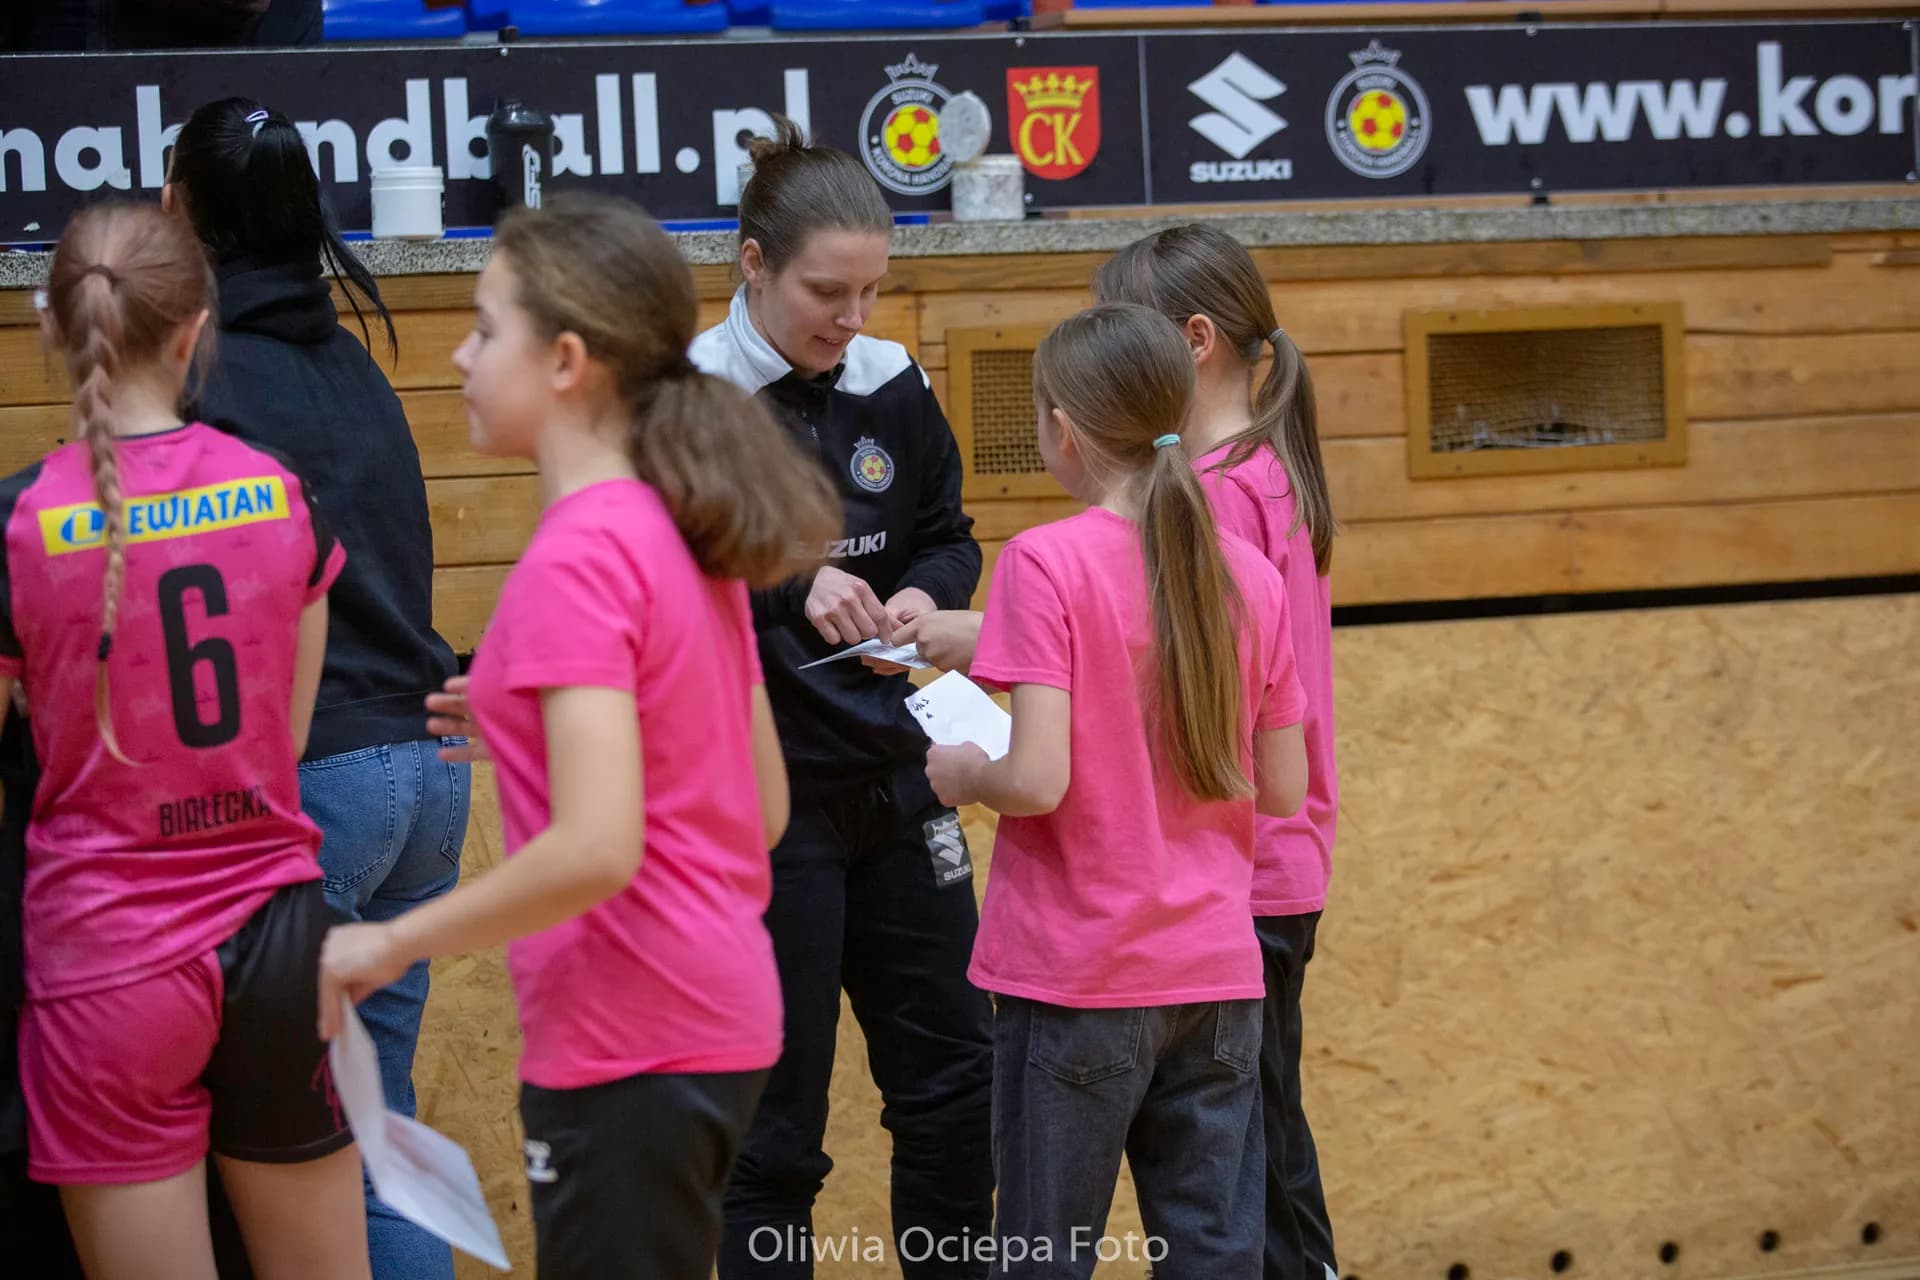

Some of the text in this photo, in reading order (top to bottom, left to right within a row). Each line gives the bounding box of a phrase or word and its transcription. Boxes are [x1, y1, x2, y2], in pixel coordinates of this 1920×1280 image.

[1019, 112, 1083, 167] CK
[1189, 158, 1293, 183] SUZUKI
[828, 530, 887, 559] ZUKI
[157, 563, 242, 750] 6
